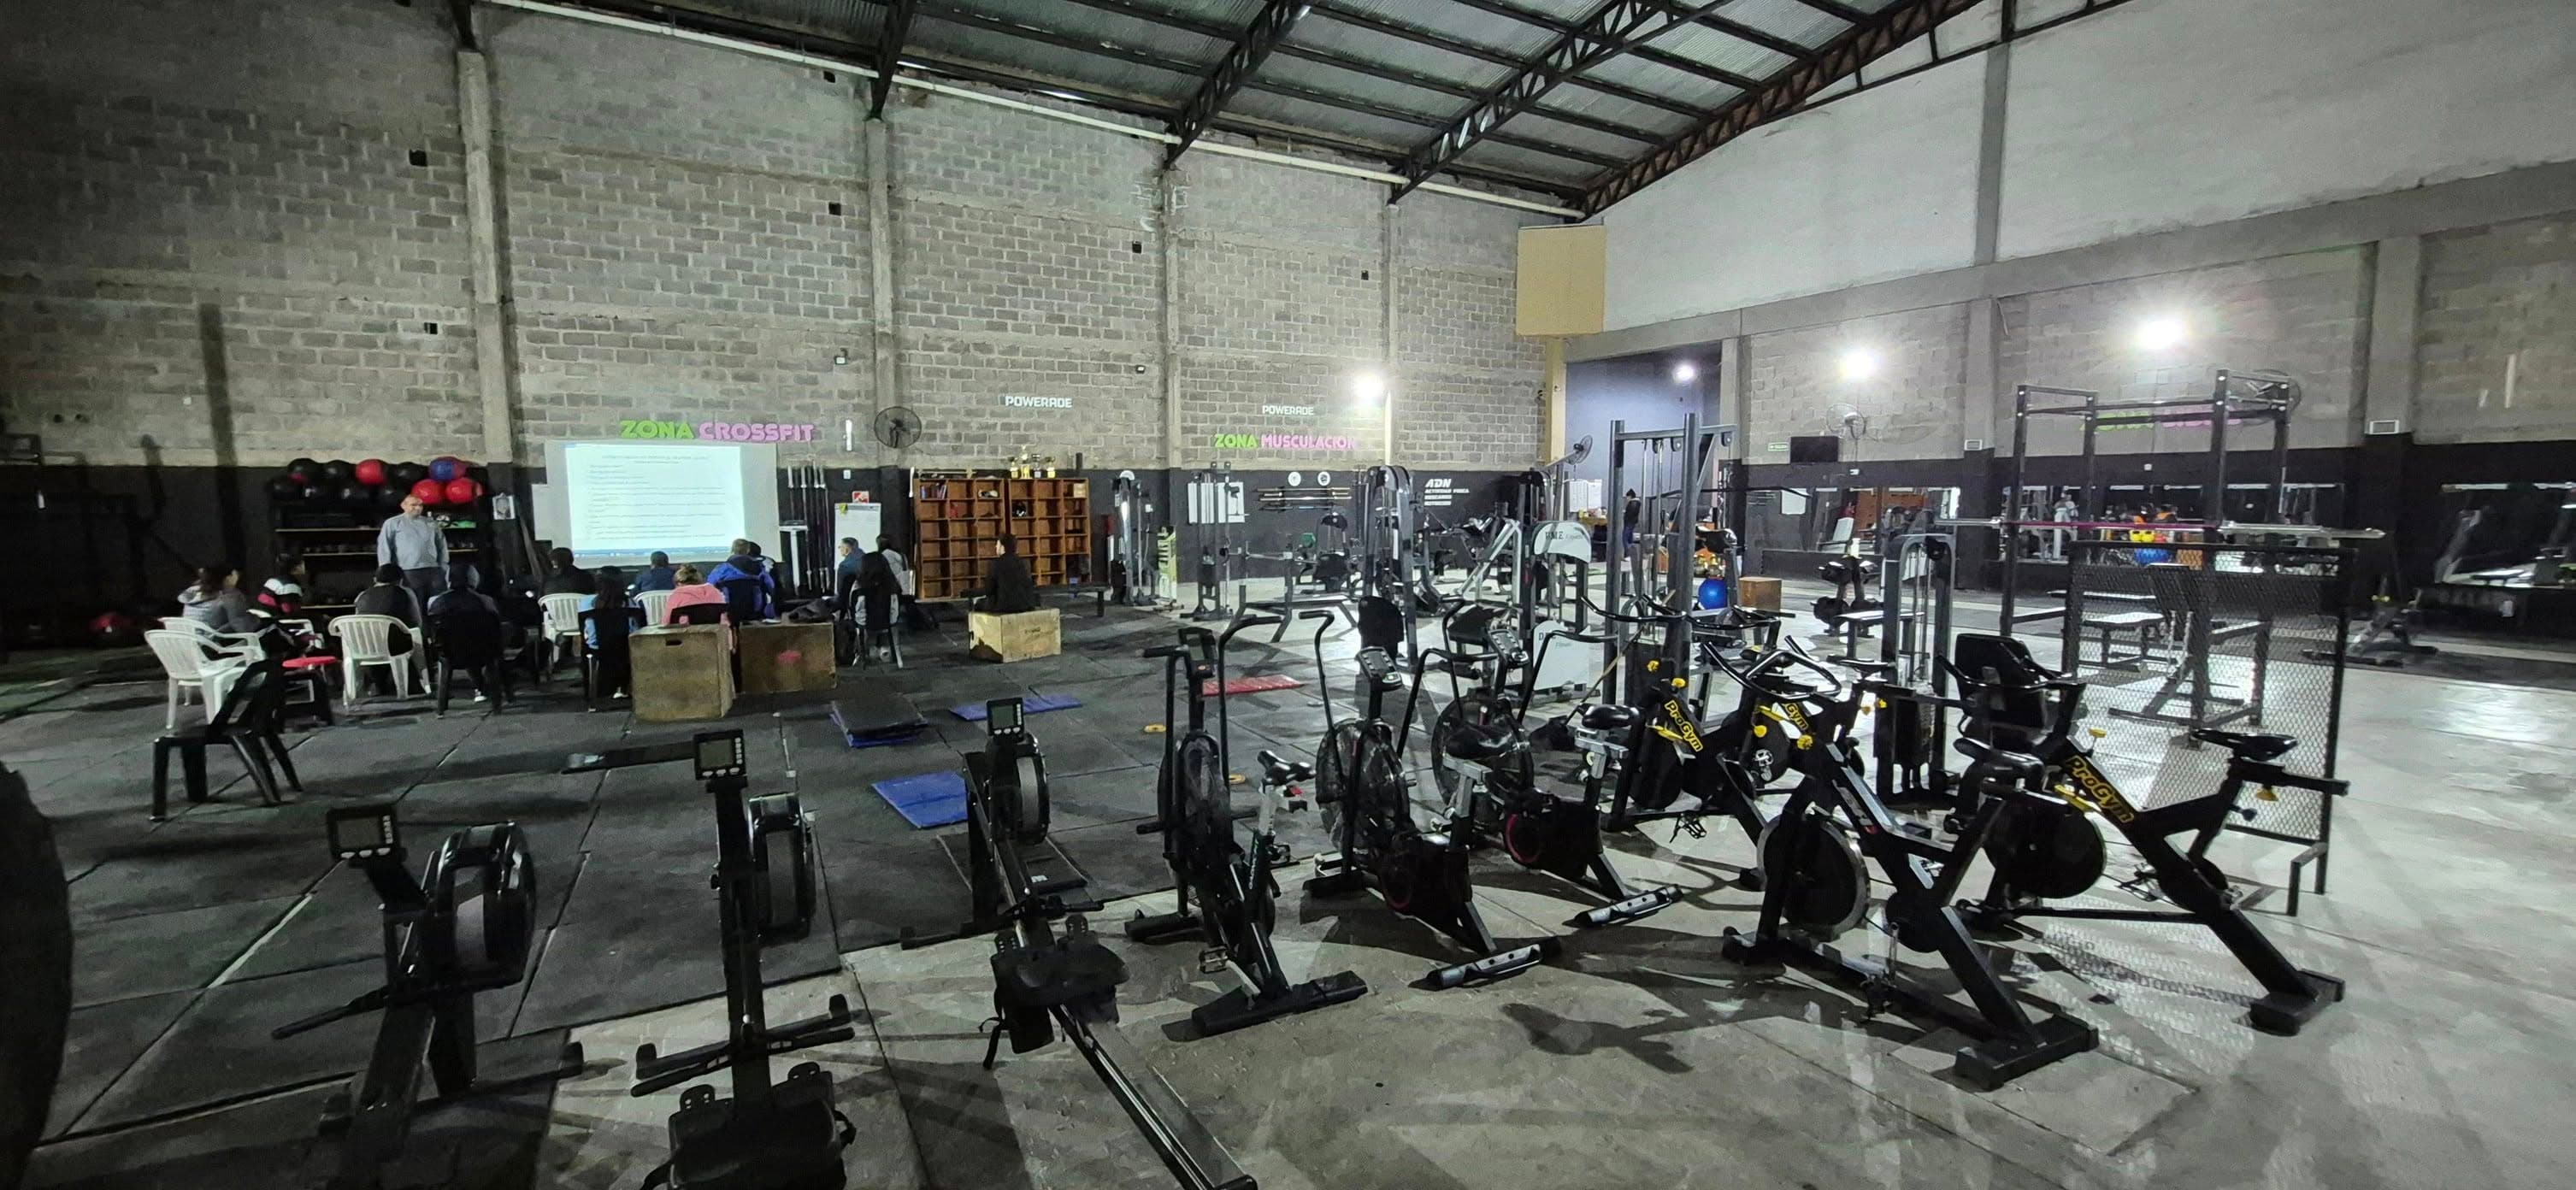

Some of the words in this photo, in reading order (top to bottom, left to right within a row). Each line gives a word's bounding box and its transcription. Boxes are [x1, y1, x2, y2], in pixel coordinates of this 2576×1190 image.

[1005, 396, 1073, 408] POWERADE
[1262, 405, 1314, 415] POWERADE
[620, 420, 694, 439] ZONA
[699, 422, 814, 442] CROSSFIT
[1215, 433, 1258, 448] ZONA
[1424, 479, 1452, 488] ADN
[1665, 699, 1704, 752] ProGym
[2066, 755, 2135, 823] ProGym
